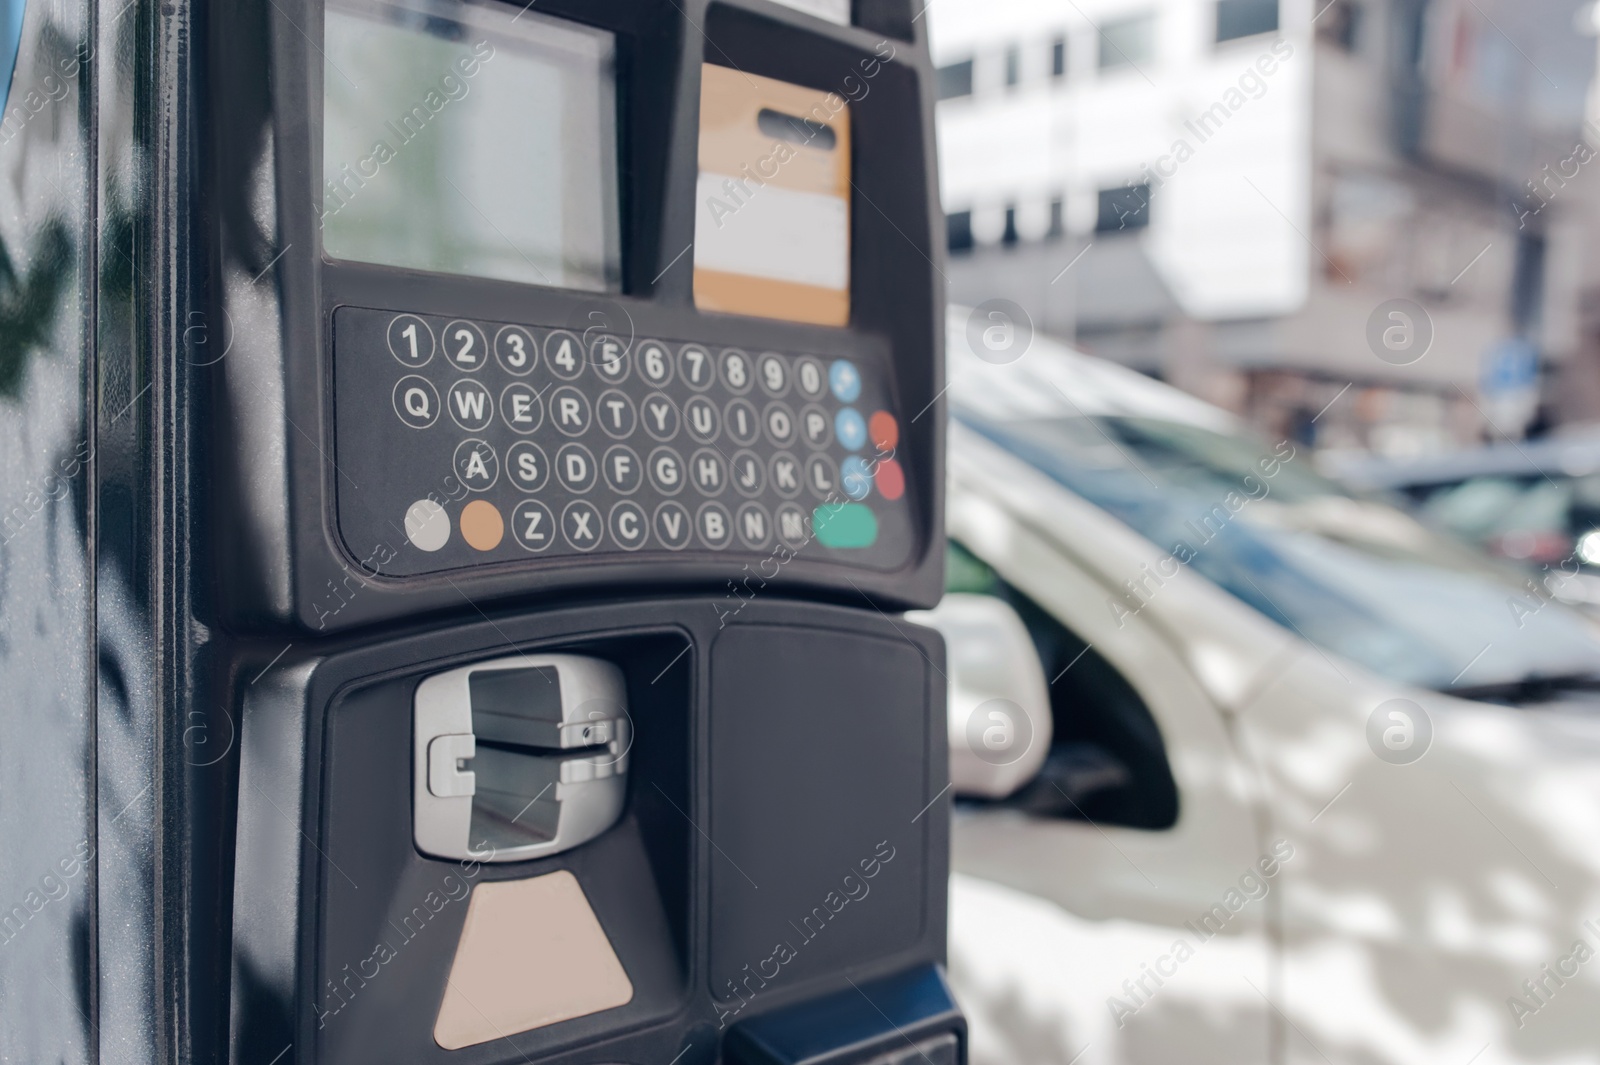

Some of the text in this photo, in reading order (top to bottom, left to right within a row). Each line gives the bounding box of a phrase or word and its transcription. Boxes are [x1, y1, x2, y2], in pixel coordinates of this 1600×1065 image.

[402, 324, 820, 393] 1 2 3 4 5 6 7 8 9 0
[404, 387, 825, 439] Q W E R T Y U I O P
[465, 451, 832, 490] A S D F G H J K L
[524, 511, 803, 540] Z X C V B N M
